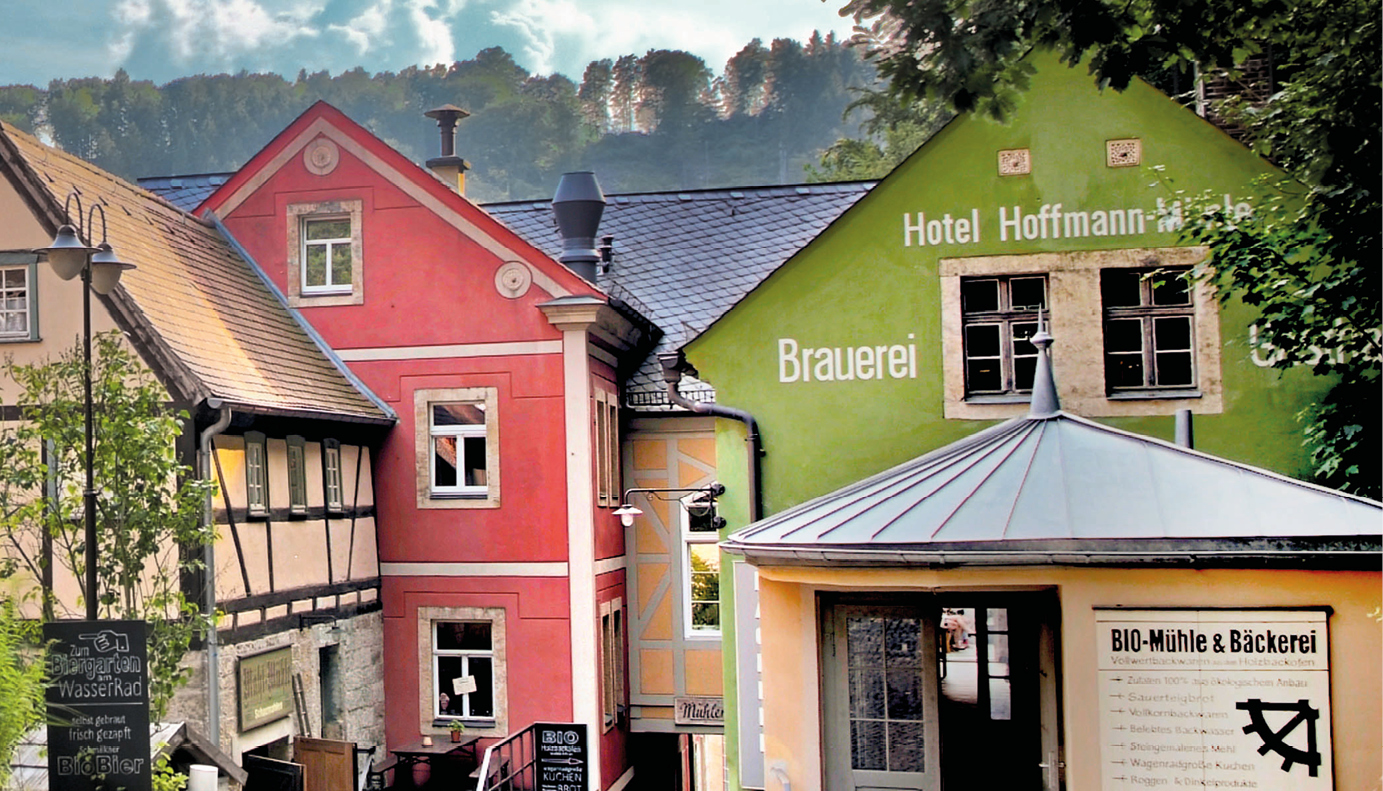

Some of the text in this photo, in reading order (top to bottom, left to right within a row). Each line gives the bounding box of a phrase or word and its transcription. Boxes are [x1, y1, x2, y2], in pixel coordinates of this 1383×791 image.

[904, 208, 980, 247] Hotel
[778, 333, 917, 383] Brauerei
[1111, 629, 1317, 654] BIO-Mühle & Bäckerei
[70, 645, 90, 657] Zum
[51, 653, 141, 681] Biergarten
[1239, 658, 1315, 667] Holzbackofen
[1277, 678, 1308, 687] Anbau
[1128, 692, 1215, 705] Sauerteigbrot
[1129, 708, 1229, 719] Vollkornbackwaren
[95, 715, 126, 727] gebraut
[69, 726, 131, 743] frisch gezapft
[542, 730, 580, 745] BIO
[1215, 761, 1256, 771] Kuchen
[543, 771, 582, 783] KUCHEN
